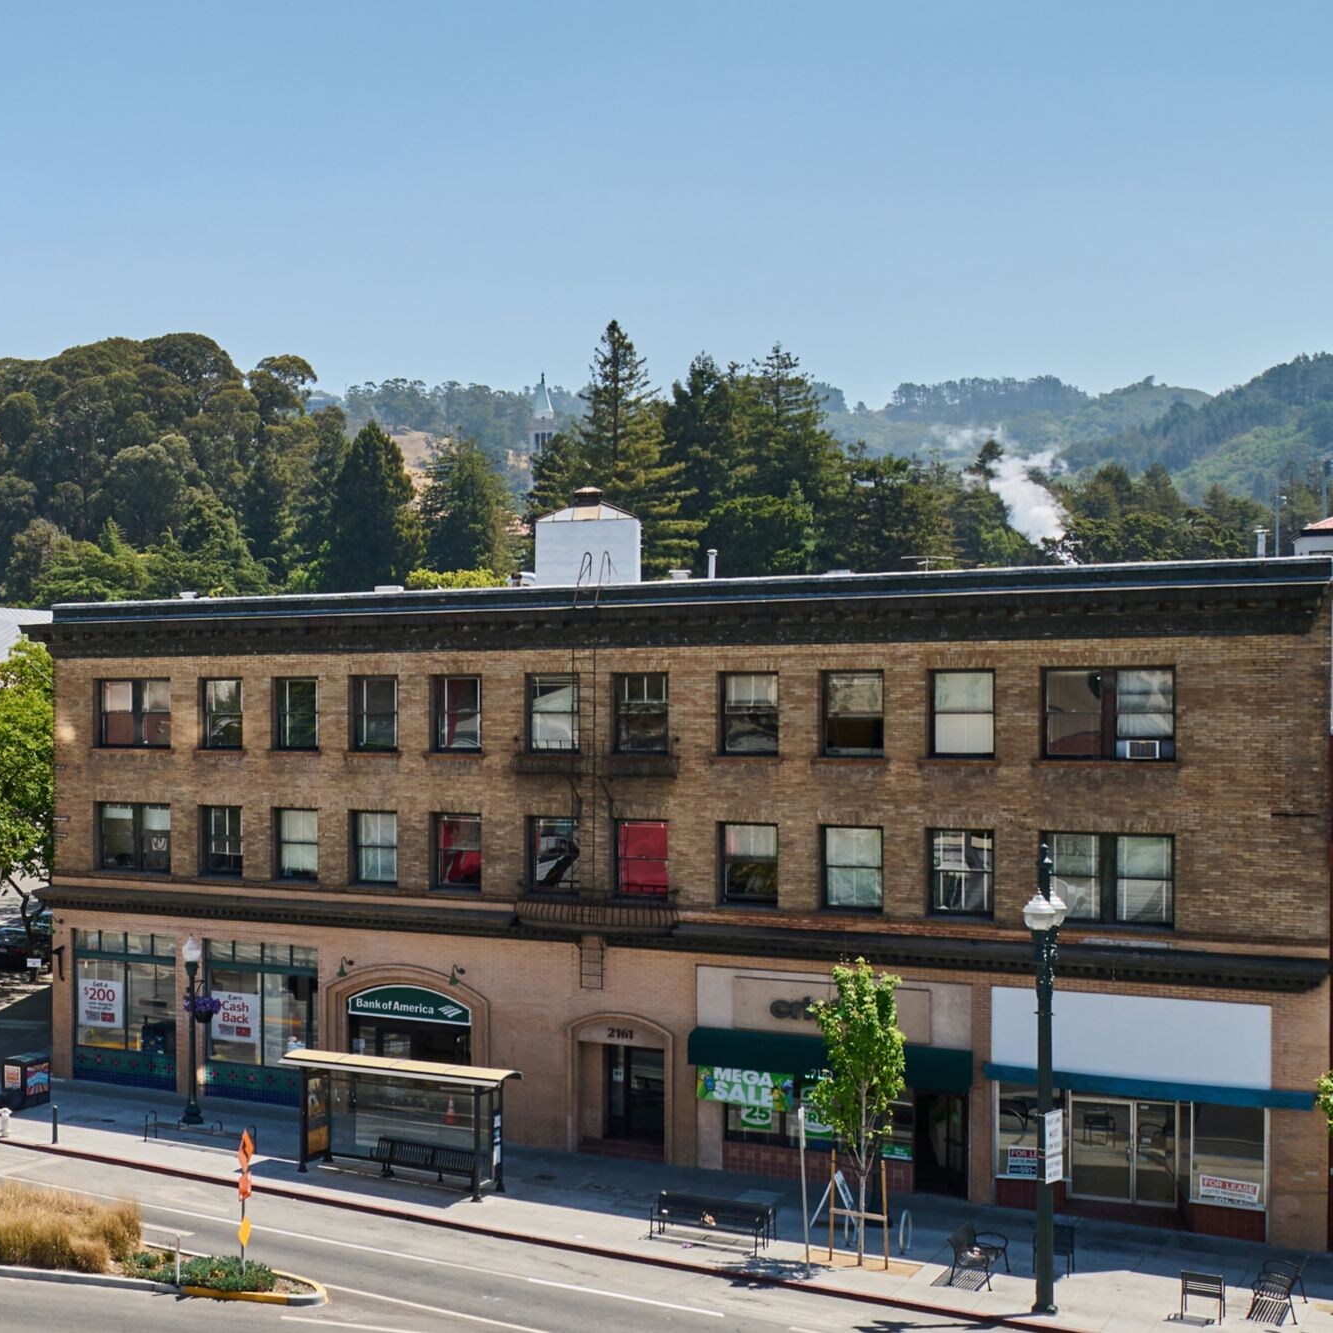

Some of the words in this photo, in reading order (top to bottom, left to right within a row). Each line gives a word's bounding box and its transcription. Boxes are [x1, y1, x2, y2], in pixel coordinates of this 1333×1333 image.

[84, 987, 116, 1002] $200
[222, 1000, 249, 1012] Cash
[356, 998, 381, 1009] Bank
[382, 1001, 392, 1010] of
[393, 1002, 434, 1015] America
[222, 1012, 249, 1024] Back
[607, 1027, 634, 1040] 2161
[713, 1066, 773, 1087] MEGA
[713, 1081, 774, 1107] SALE
[745, 1105, 771, 1120] 25
[1203, 1179, 1222, 1188] FOR
[1225, 1181, 1255, 1194] LEASE
